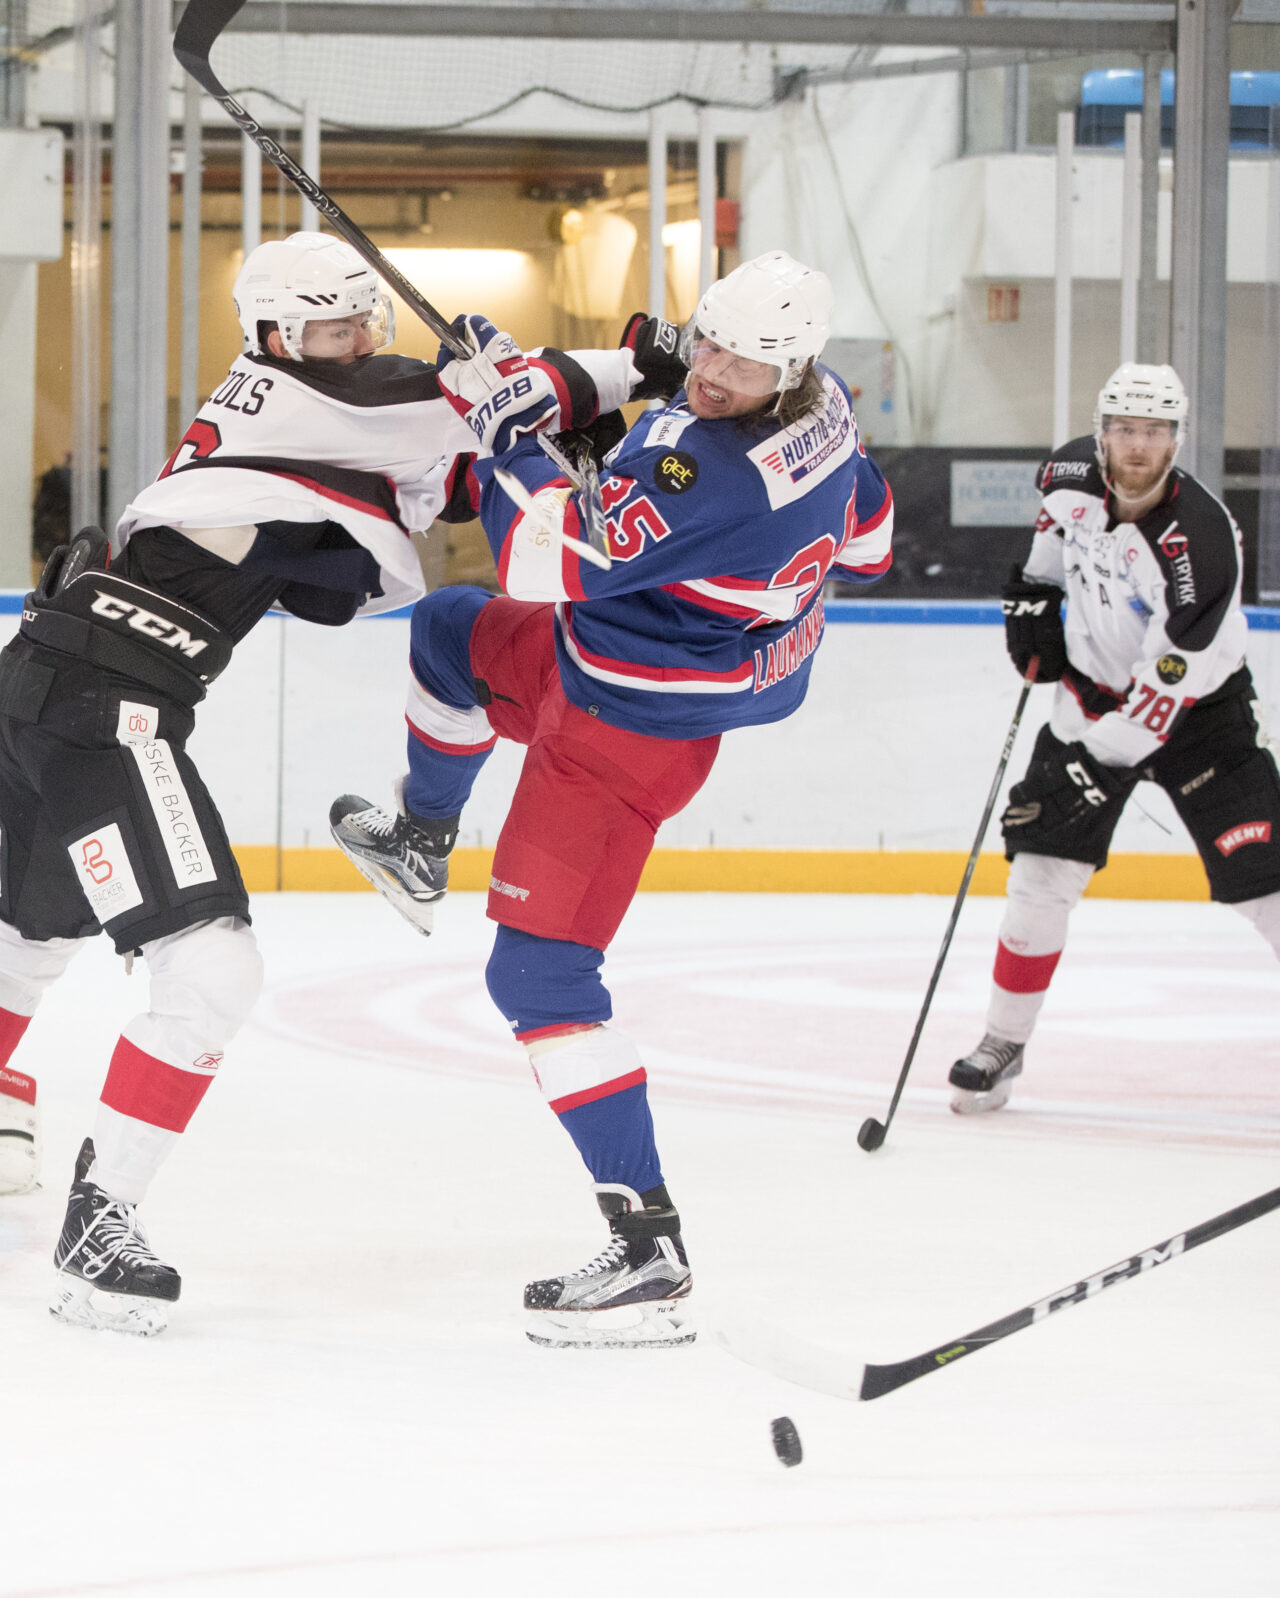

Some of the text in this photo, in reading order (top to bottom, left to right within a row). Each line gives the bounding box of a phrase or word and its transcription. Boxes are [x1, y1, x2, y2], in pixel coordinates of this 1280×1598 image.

[221, 95, 340, 218] EASTON
[1097, 582, 1113, 610] A
[1173, 551, 1196, 606] TRYKK
[90, 589, 209, 659] CCM
[1129, 684, 1176, 733] 78
[161, 794, 204, 876] BACKER
[1220, 824, 1267, 850] MENY
[91, 881, 125, 907] BACKER
[1032, 1232, 1186, 1324] CCM
